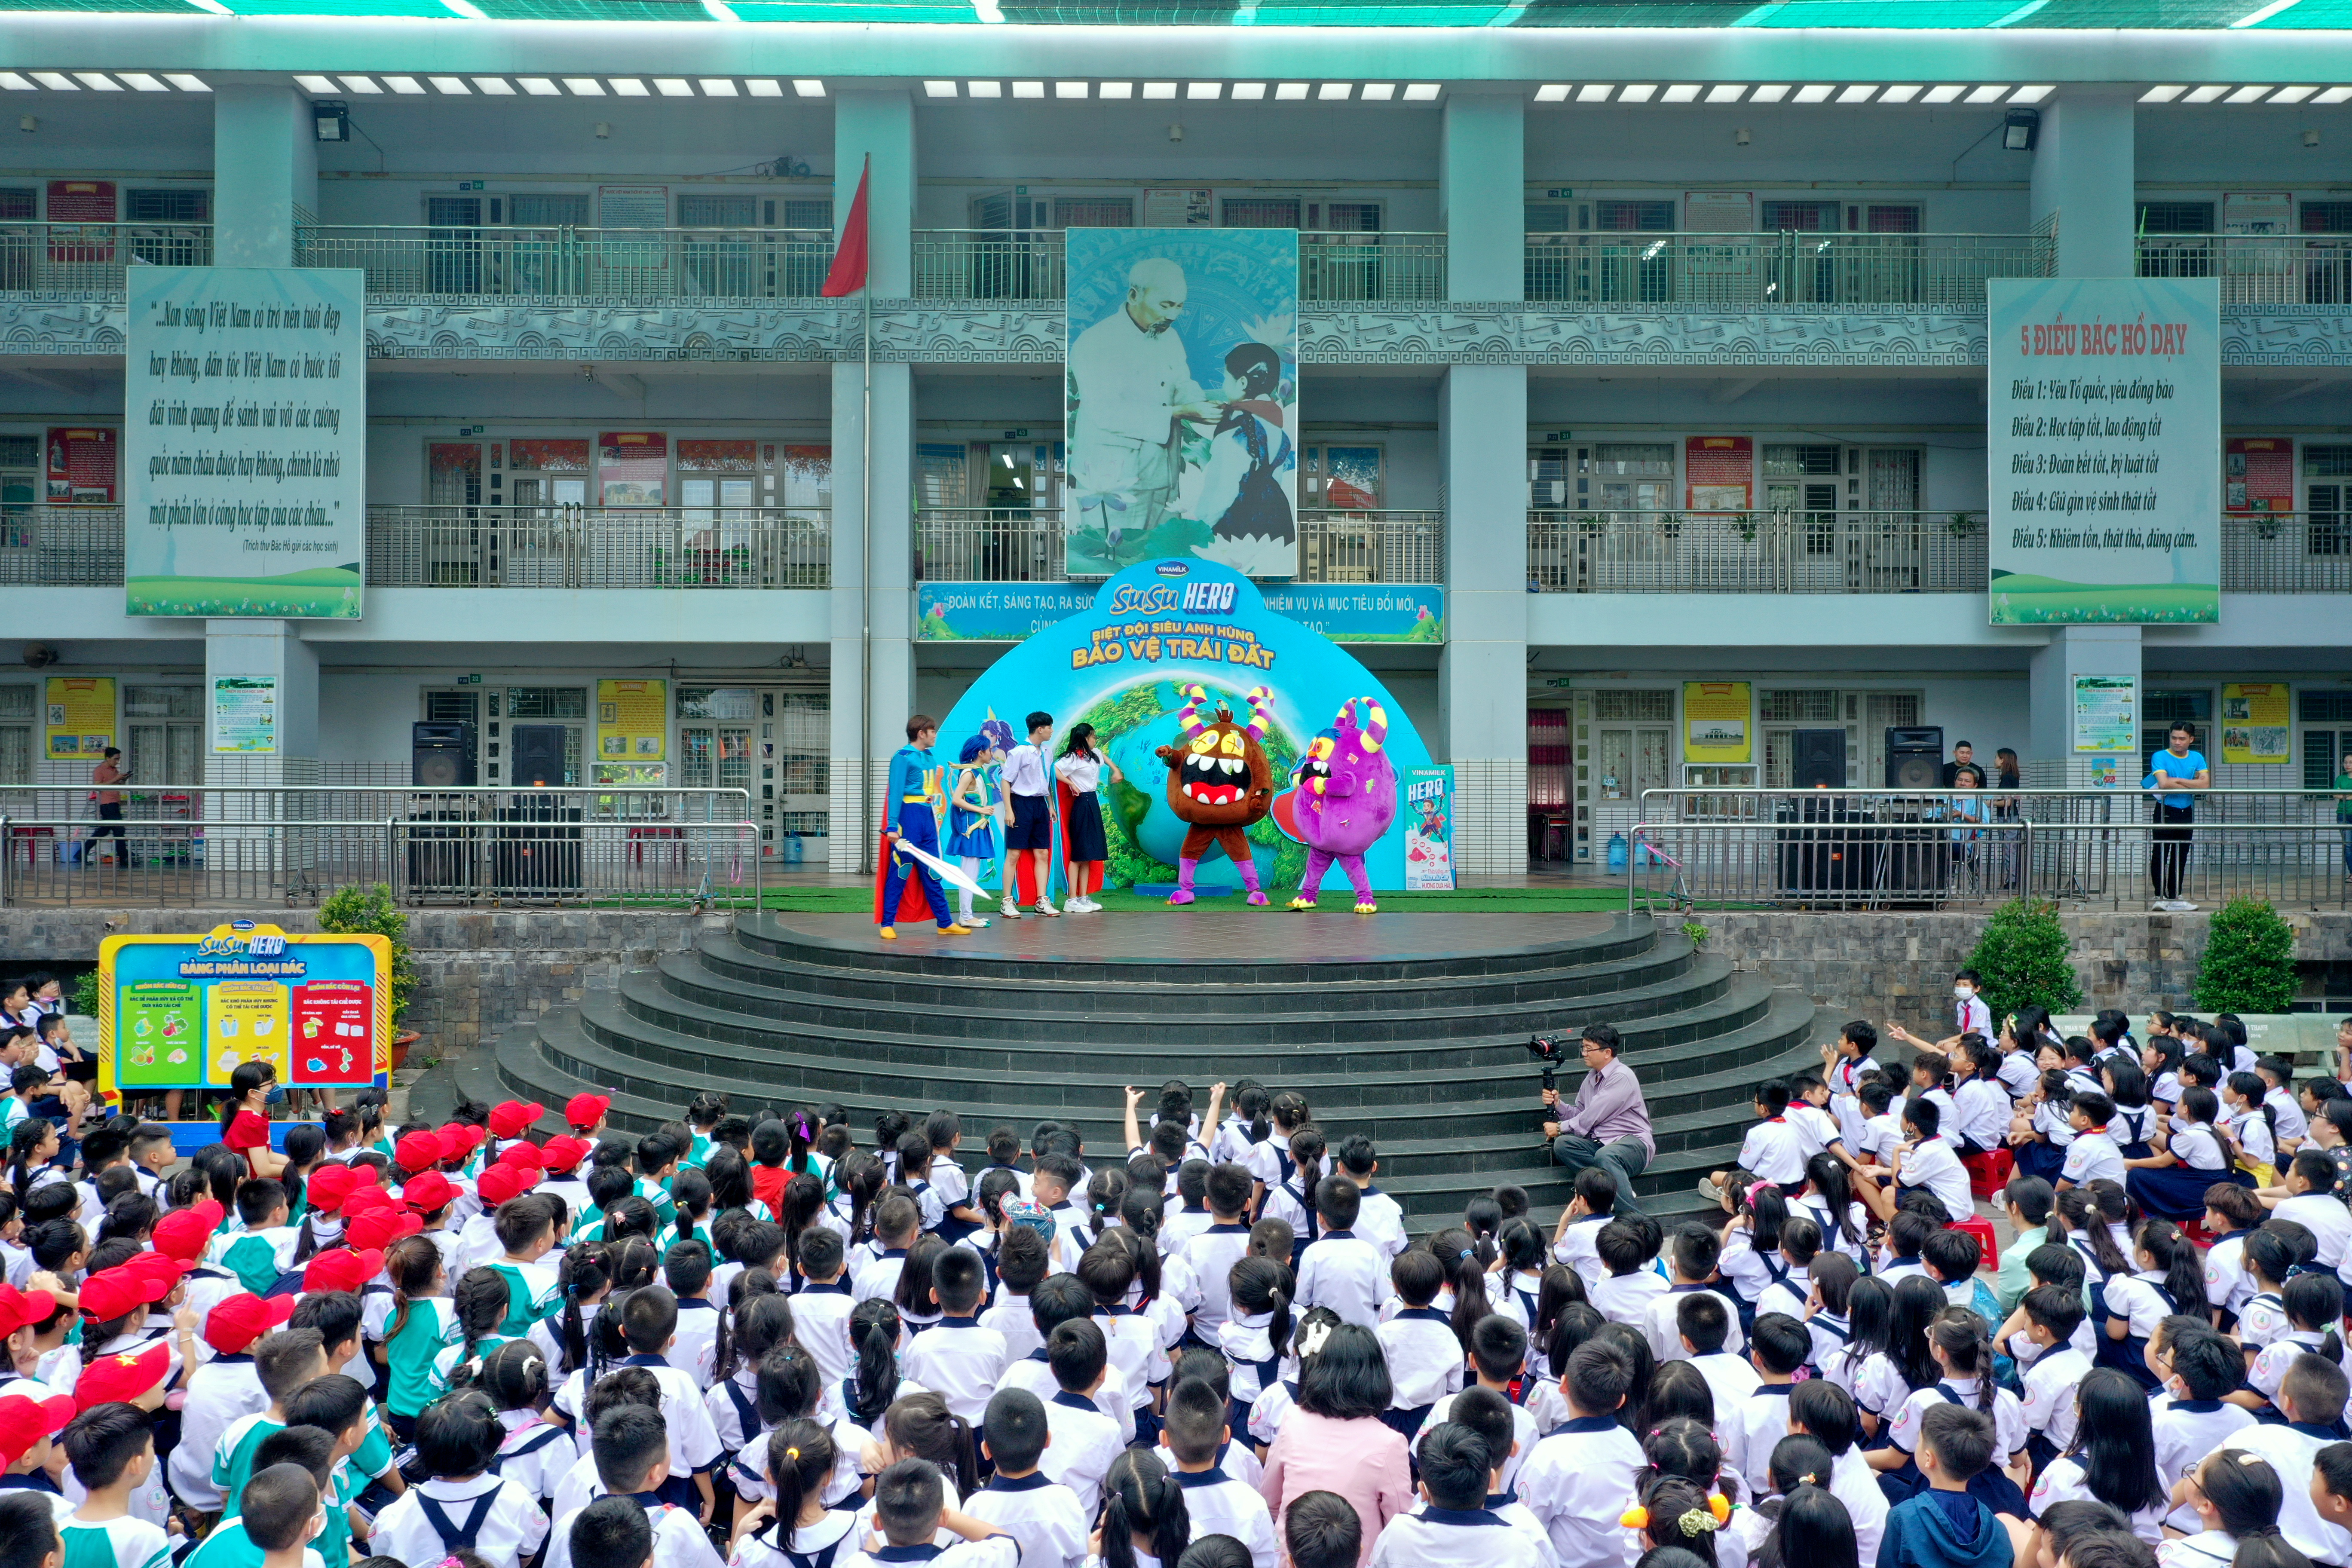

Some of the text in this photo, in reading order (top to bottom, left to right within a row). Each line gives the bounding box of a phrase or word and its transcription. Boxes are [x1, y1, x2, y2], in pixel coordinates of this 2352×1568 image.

[184, 300, 205, 334] sông
[210, 301, 227, 334] Việt
[230, 303, 250, 328] Nam
[254, 301, 263, 328] có
[267, 303, 280, 328] trở
[284, 304, 300, 328] nên
[304, 303, 321, 329] tươi
[324, 303, 340, 336] đẹp
[2021, 312, 2187, 362] 5 ĐIỀU BÁC HỒ DẠY
[150, 351, 340, 383] hay không, dân tộc Việt Nam có bước tới
[2012, 375, 2173, 404] Điều 1: Yêu Tổ quốc, yêu đồng bào
[149, 395, 339, 434] đài vinh quang để sánh vai với các cường
[2012, 413, 2162, 441] Điều 2: Học tập tốt, lao động tốt
[150, 444, 340, 483] quốc năm châu được hay không, chính là nhờ
[2012, 450, 2159, 479] Điều 3: Đoàn kết tốt, kỷ luật tốt
[150, 499, 165, 530] một
[168, 494, 191, 532] phần
[193, 499, 206, 524] lớn
[209, 499, 214, 525] ở
[216, 499, 236, 532] công
[238, 500, 253, 532] học
[255, 499, 268, 532] tập
[271, 499, 286, 526] của
[289, 500, 302, 527] các
[2012, 487, 2156, 516] Điều 4: Giữ gìn vệ sinh thật tốt
[243, 538, 338, 554] (Trích thư Bác Hồ gửi các học sinh)
[2012, 524, 2197, 553] Điều 5: Khiêm tốn, thật thà, dũng cảm.
[979, 591, 1001, 610] KẾT,
[1004, 592, 1031, 609] SÁNG
[1034, 595, 1056, 611] TẠO,
[1060, 596, 1072, 609] RA
[1075, 593, 1094, 609] SỨC
[1183, 582, 1238, 615] HERO
[1263, 591, 1417, 613] NHIỆM VỤ VÀ MỤC TIÊU ĐỔI MỚI,
[1092, 620, 1255, 642] BIỆT ĐỘI SIÊU ANH HÙNG
[1073, 637, 1274, 669] BẢO VỆ TRÁI ĐẤT
[1409, 778, 1446, 802] HERO
[248, 936, 286, 956] HERO
[180, 958, 306, 979] BẢNG PHÂN LOẠI RÁC
